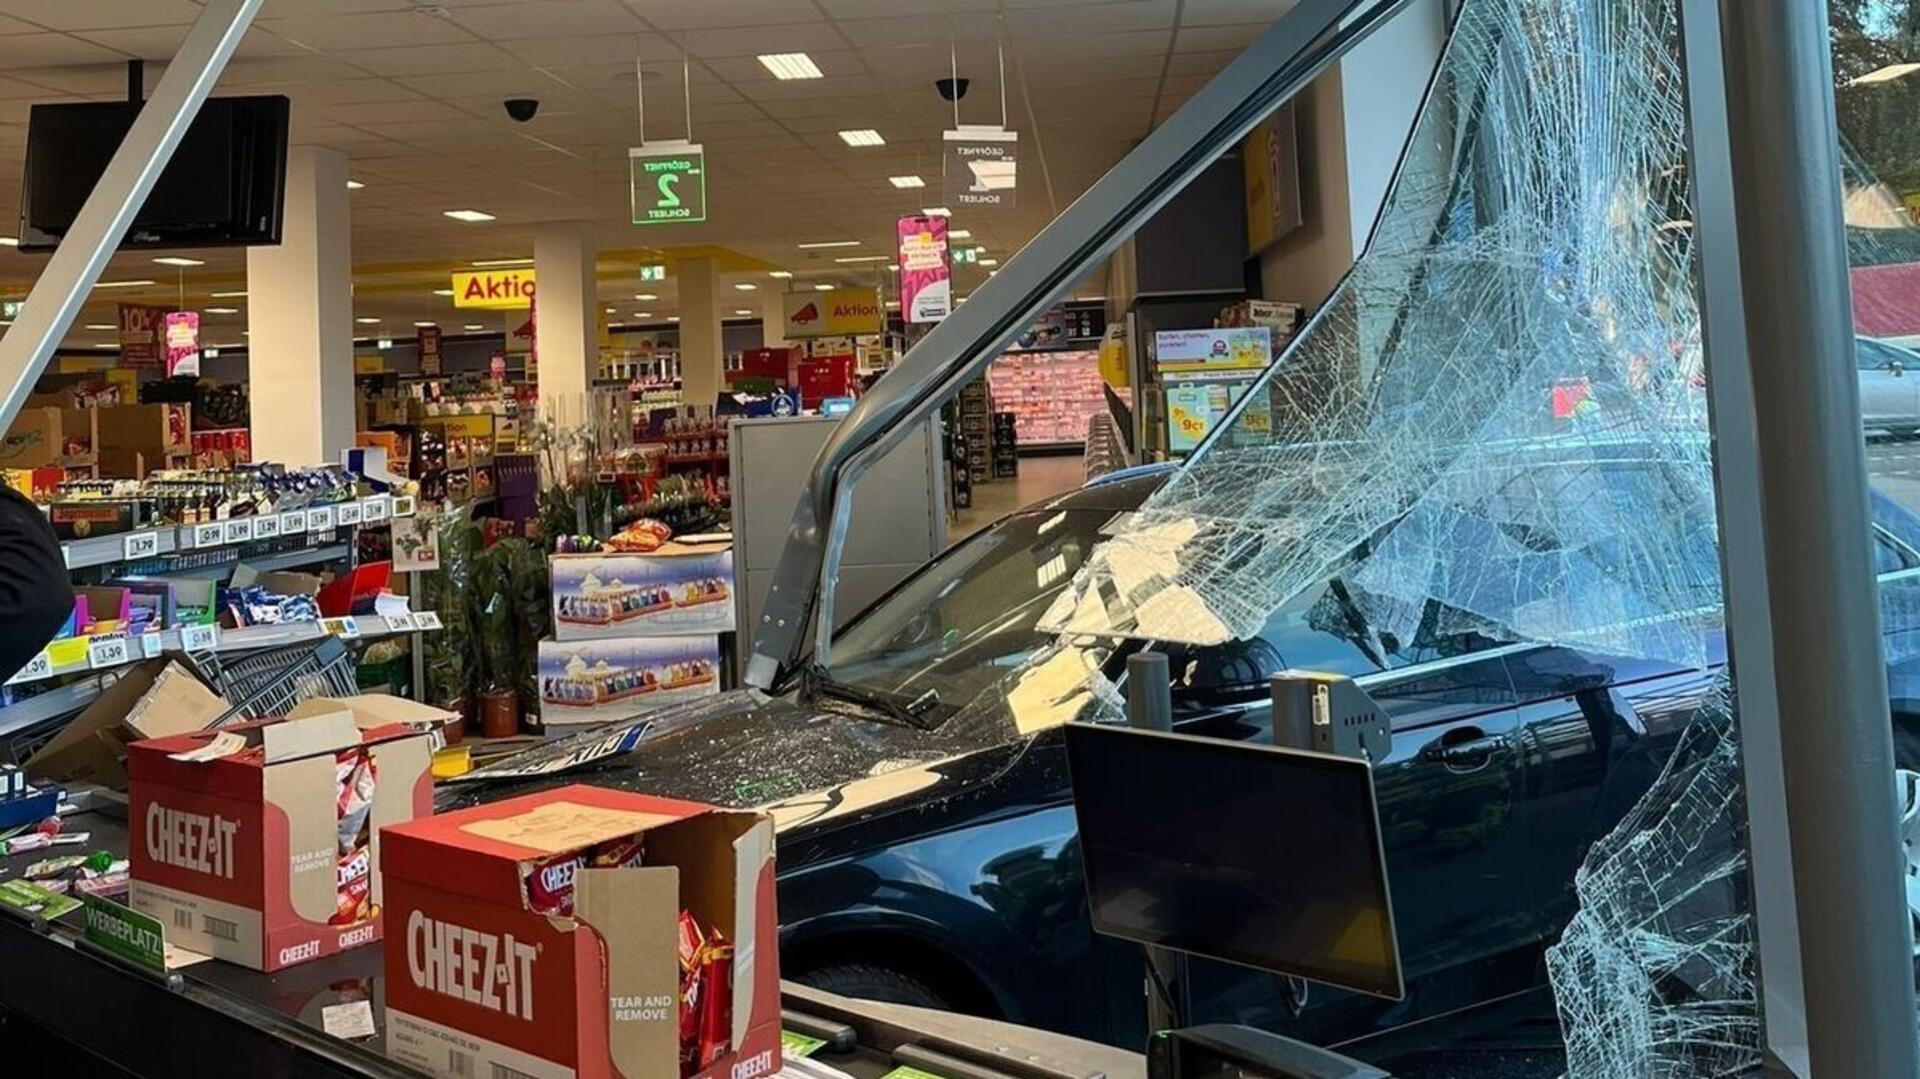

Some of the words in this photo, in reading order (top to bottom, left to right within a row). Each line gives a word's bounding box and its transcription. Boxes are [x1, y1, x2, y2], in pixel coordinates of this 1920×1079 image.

[464, 275, 536, 300] Aktio
[833, 305, 878, 317] Aktion
[611, 997, 642, 1009] TEAR
[644, 995, 672, 1007] AND
[615, 1009, 668, 1021] REMOVE
